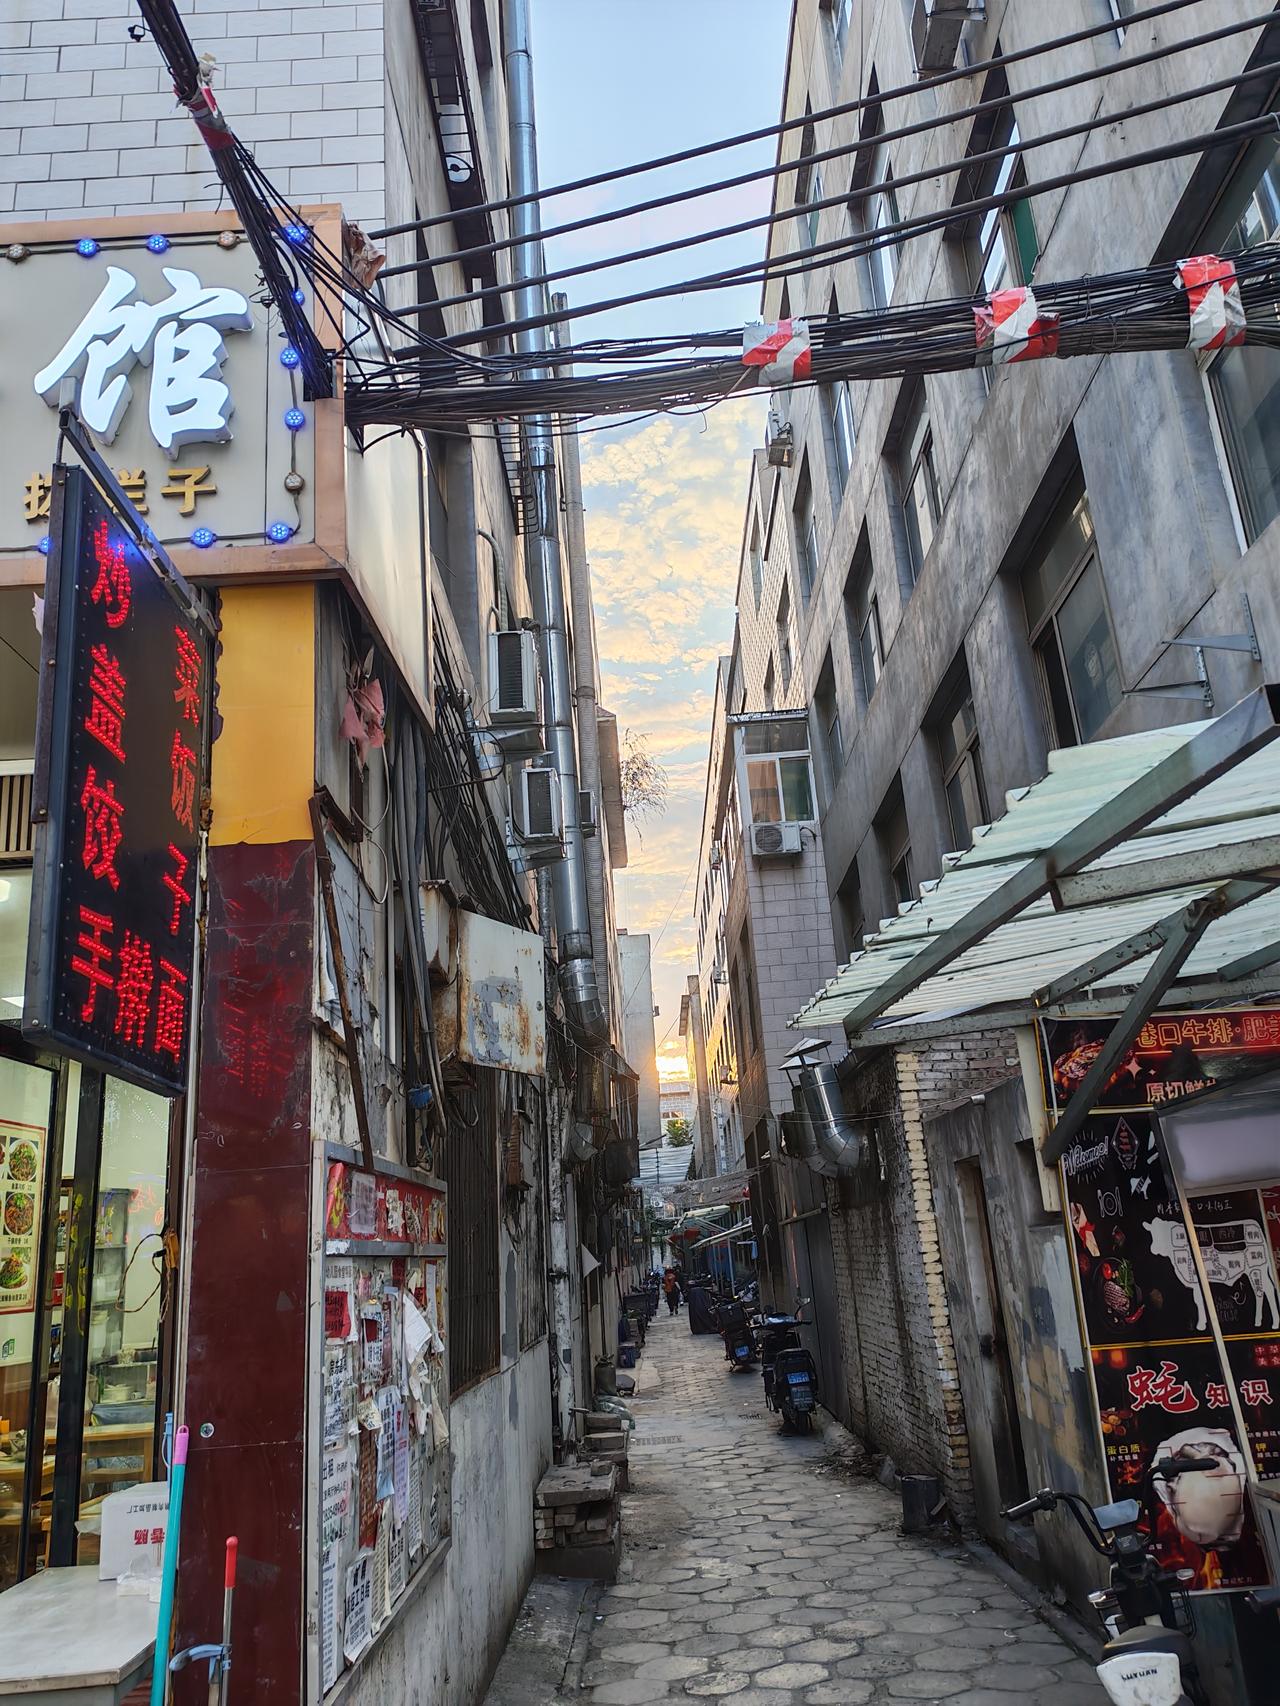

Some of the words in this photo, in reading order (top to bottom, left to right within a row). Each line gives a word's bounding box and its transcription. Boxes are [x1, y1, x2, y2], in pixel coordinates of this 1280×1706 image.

[33, 265, 253, 458] 馆
[71, 904, 188, 1064] 手擀面
